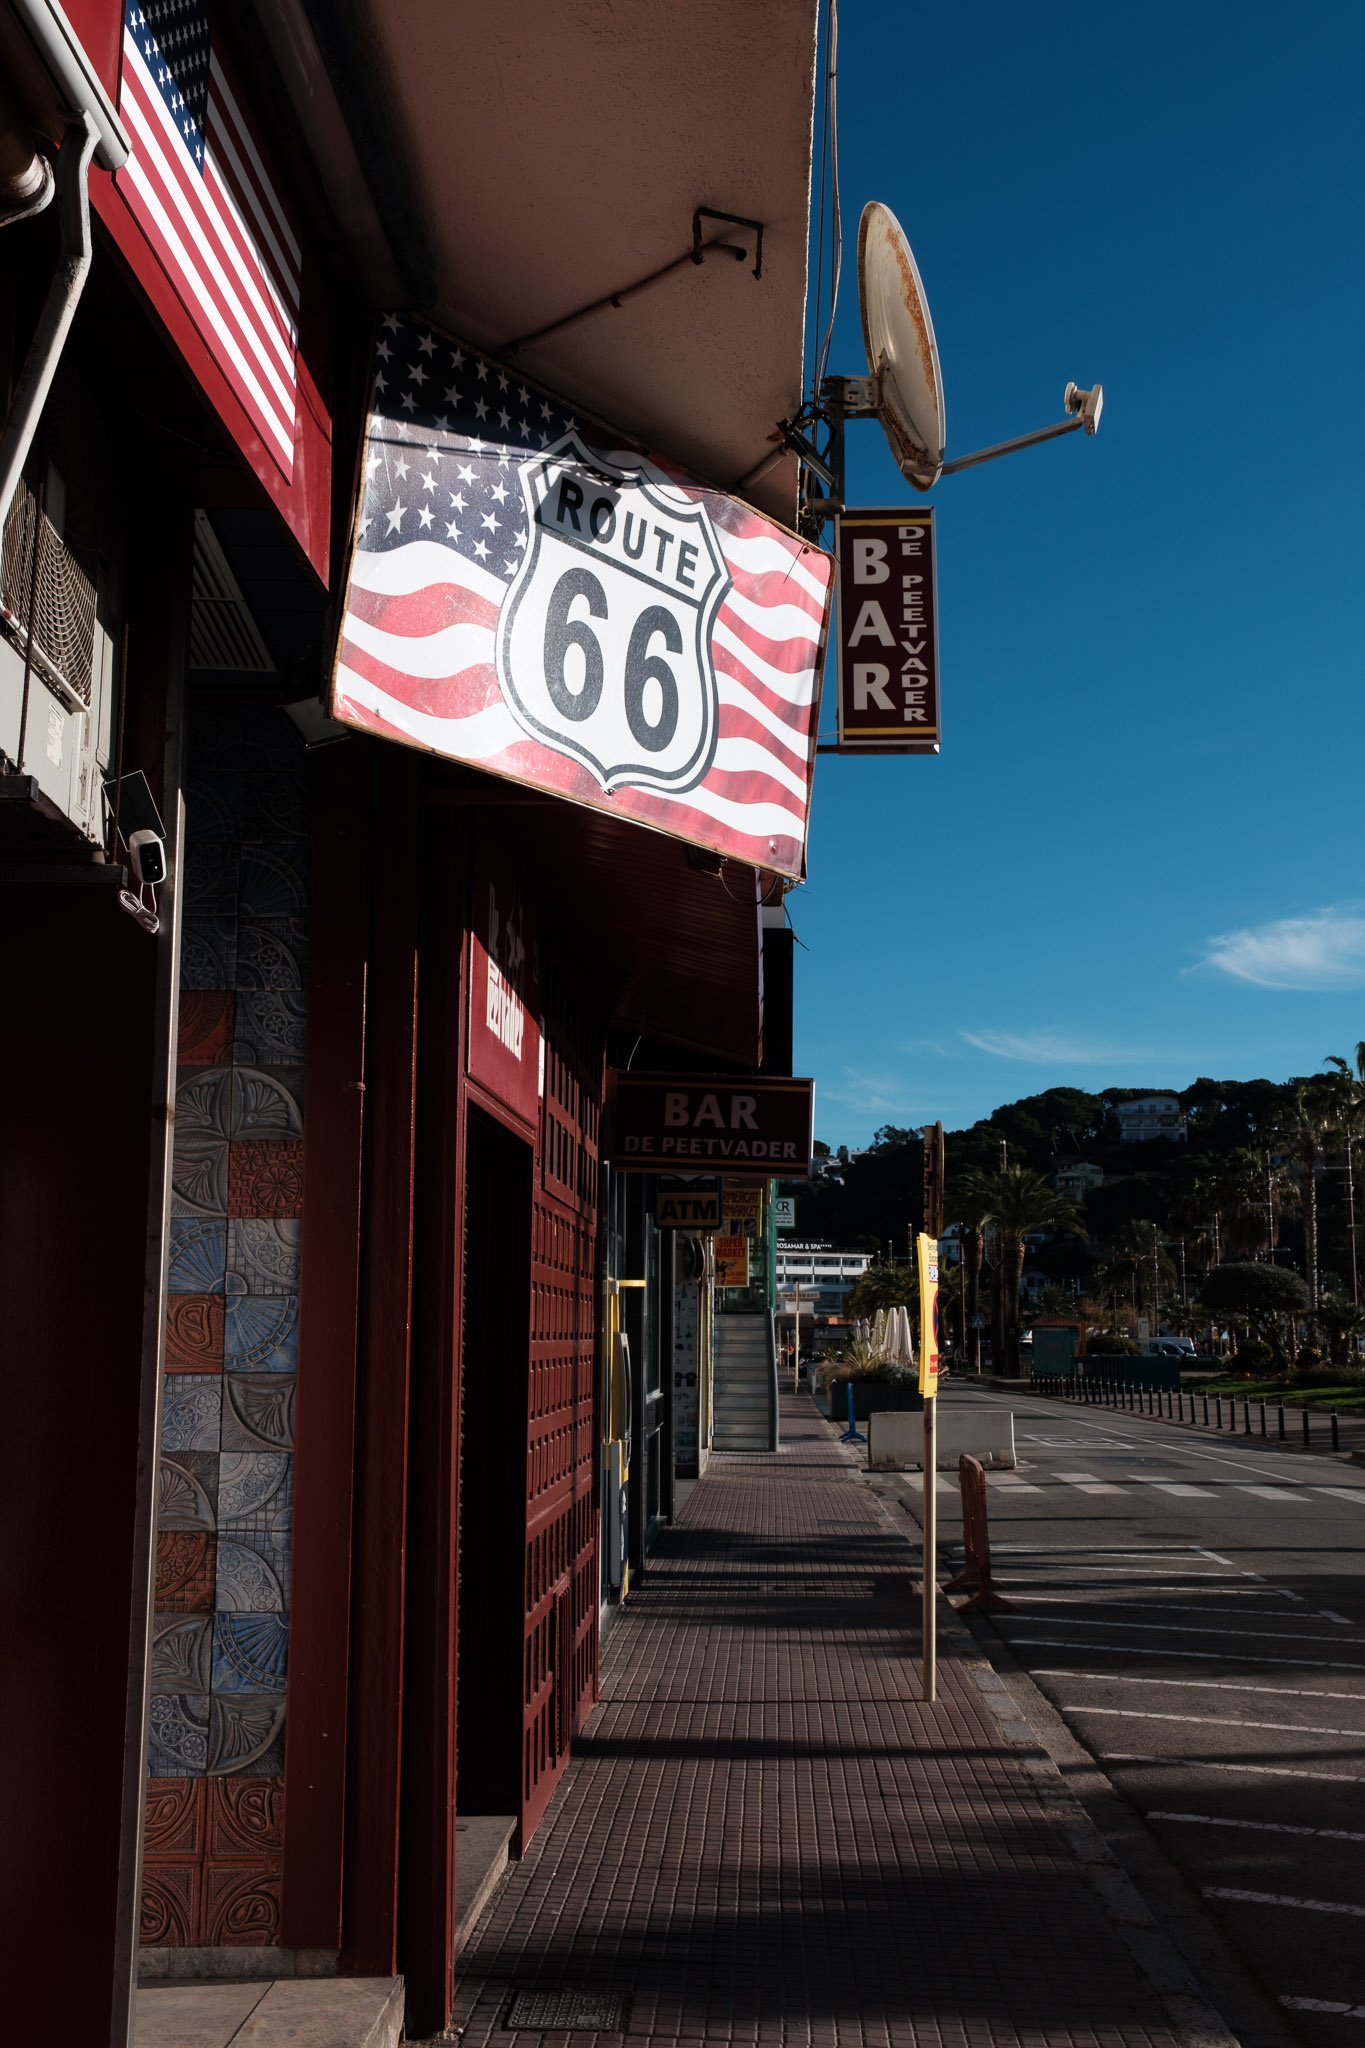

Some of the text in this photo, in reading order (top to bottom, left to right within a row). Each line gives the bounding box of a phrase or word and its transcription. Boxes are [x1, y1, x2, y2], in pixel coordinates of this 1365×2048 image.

[556, 477, 701, 588] ROUTE
[848, 538, 896, 710] BAR
[898, 526, 929, 722] DE PEETVADER
[543, 567, 684, 753] 66
[663, 1091, 760, 1130] BAR
[624, 1135, 798, 1160] DE PEETVADER
[661, 1200, 716, 1219] ATM
[716, 1248, 746, 1258] MARKET
[718, 1238, 743, 1248] SUPER
